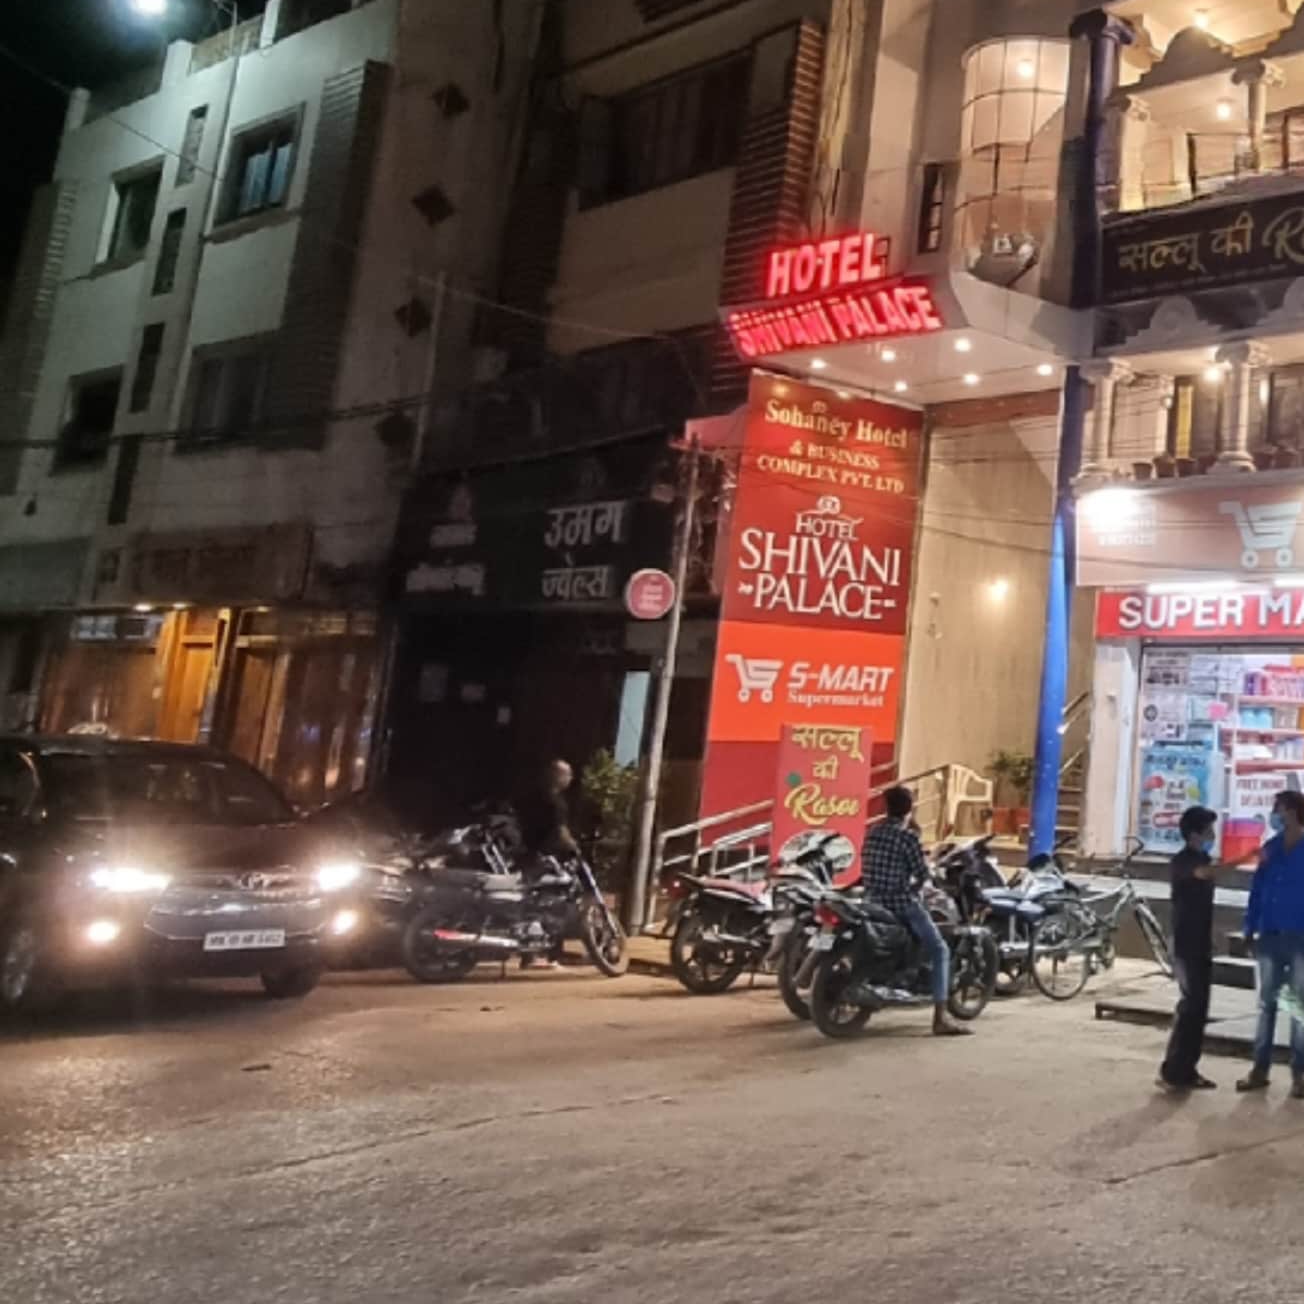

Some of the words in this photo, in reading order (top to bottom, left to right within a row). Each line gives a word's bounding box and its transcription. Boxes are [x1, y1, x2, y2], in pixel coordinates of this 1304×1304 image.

[1117, 231, 1206, 273] सल्लू
[1209, 210, 1254, 257] की
[767, 233, 882, 297] HOTEL
[831, 287, 943, 338] PALACE
[764, 398, 853, 442] Sohaney
[855, 419, 910, 448] Hotel
[757, 454, 837, 484] COMPLEX
[807, 442, 881, 470] BUSINESS
[795, 514, 861, 541] HOTEL
[738, 527, 902, 586] SHIVANI
[753, 573, 884, 620] PALACE
[1117, 594, 1246, 630] SUPER
[786, 661, 895, 694] S-MART
[787, 690, 885, 708] Supermarket
[791, 723, 865, 762] सल्लू
[812, 755, 839, 780] की
